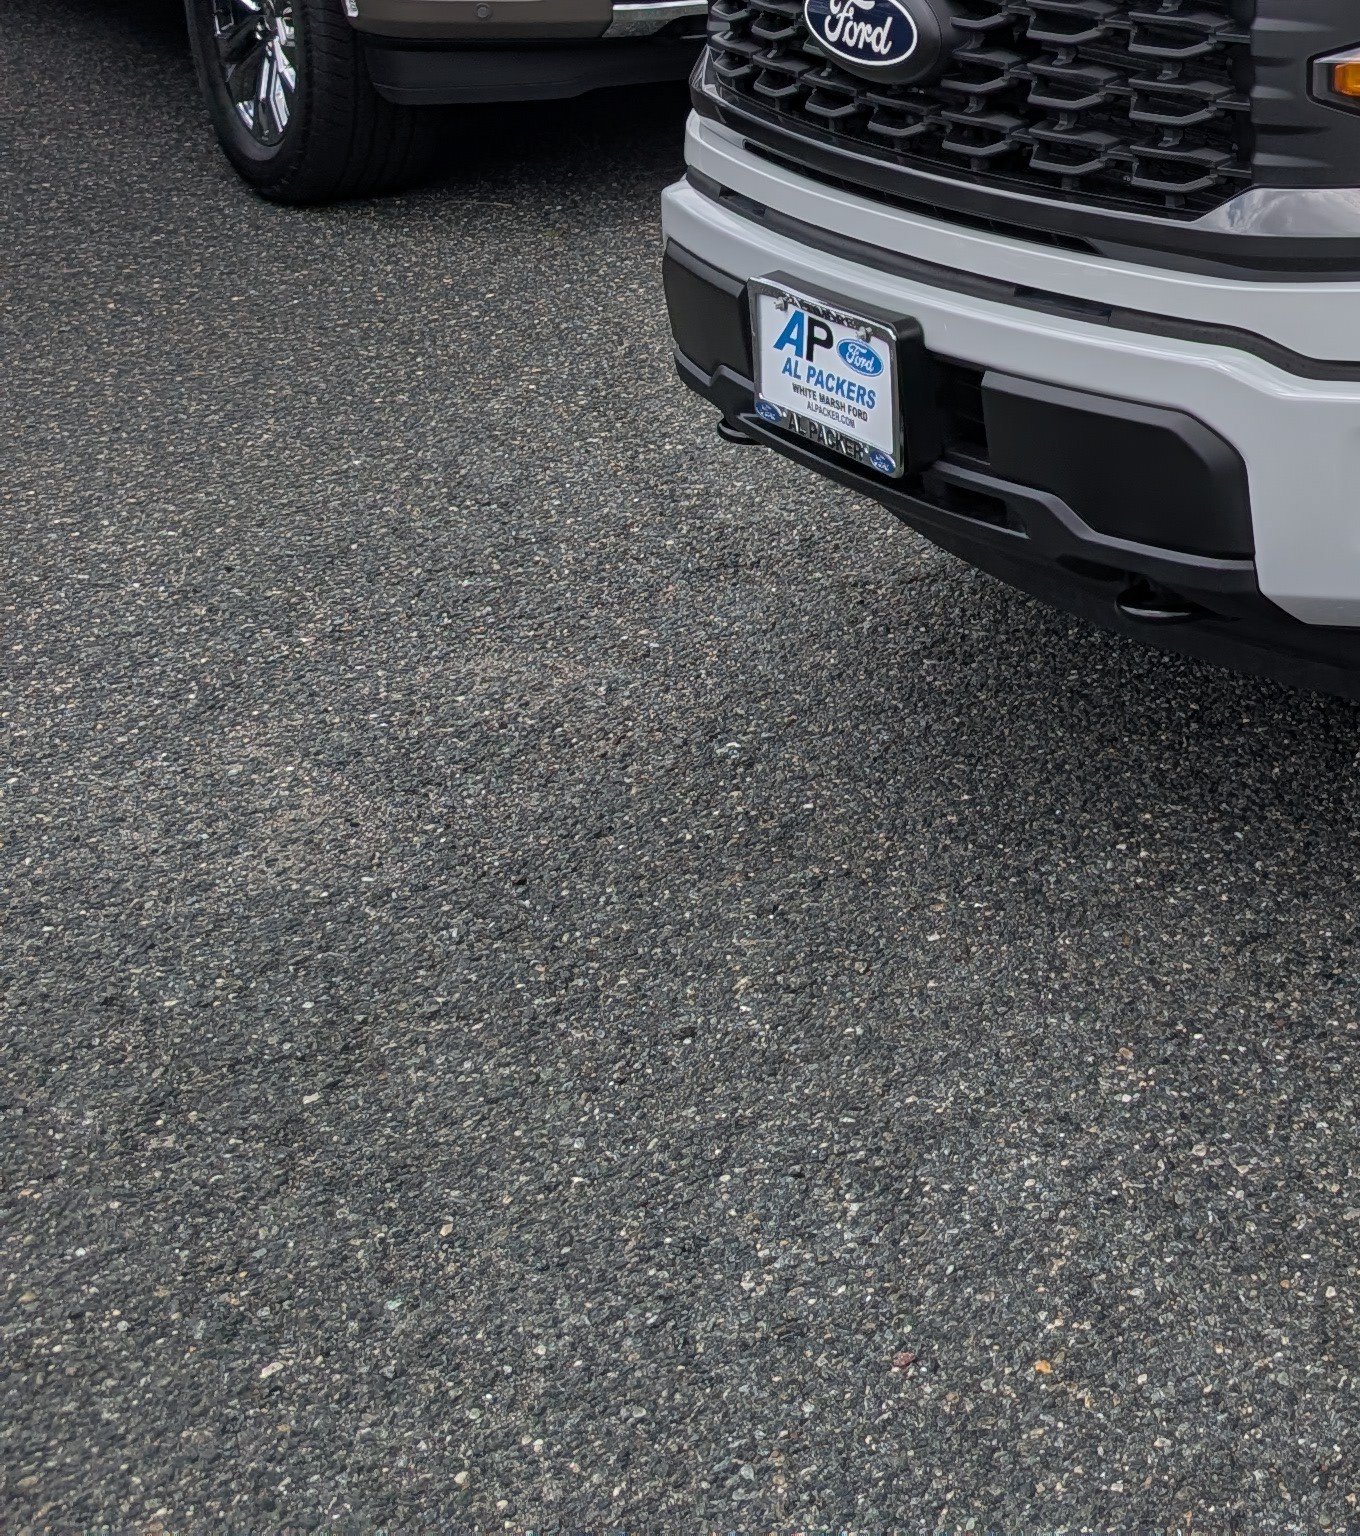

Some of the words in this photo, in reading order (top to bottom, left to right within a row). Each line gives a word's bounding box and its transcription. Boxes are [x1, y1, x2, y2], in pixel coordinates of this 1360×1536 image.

[773, 309, 834, 363] AP
[844, 342, 876, 373] Ford
[781, 356, 802, 381] AL
[806, 364, 878, 410] PACKERS
[791, 381, 817, 401] WHITE
[818, 393, 846, 413] MARSH
[847, 403, 869, 422] FORD
[788, 412, 808, 438] AL
[808, 420, 865, 462] PACKER
[806, 400, 856, 429] ALPACKER.COM
